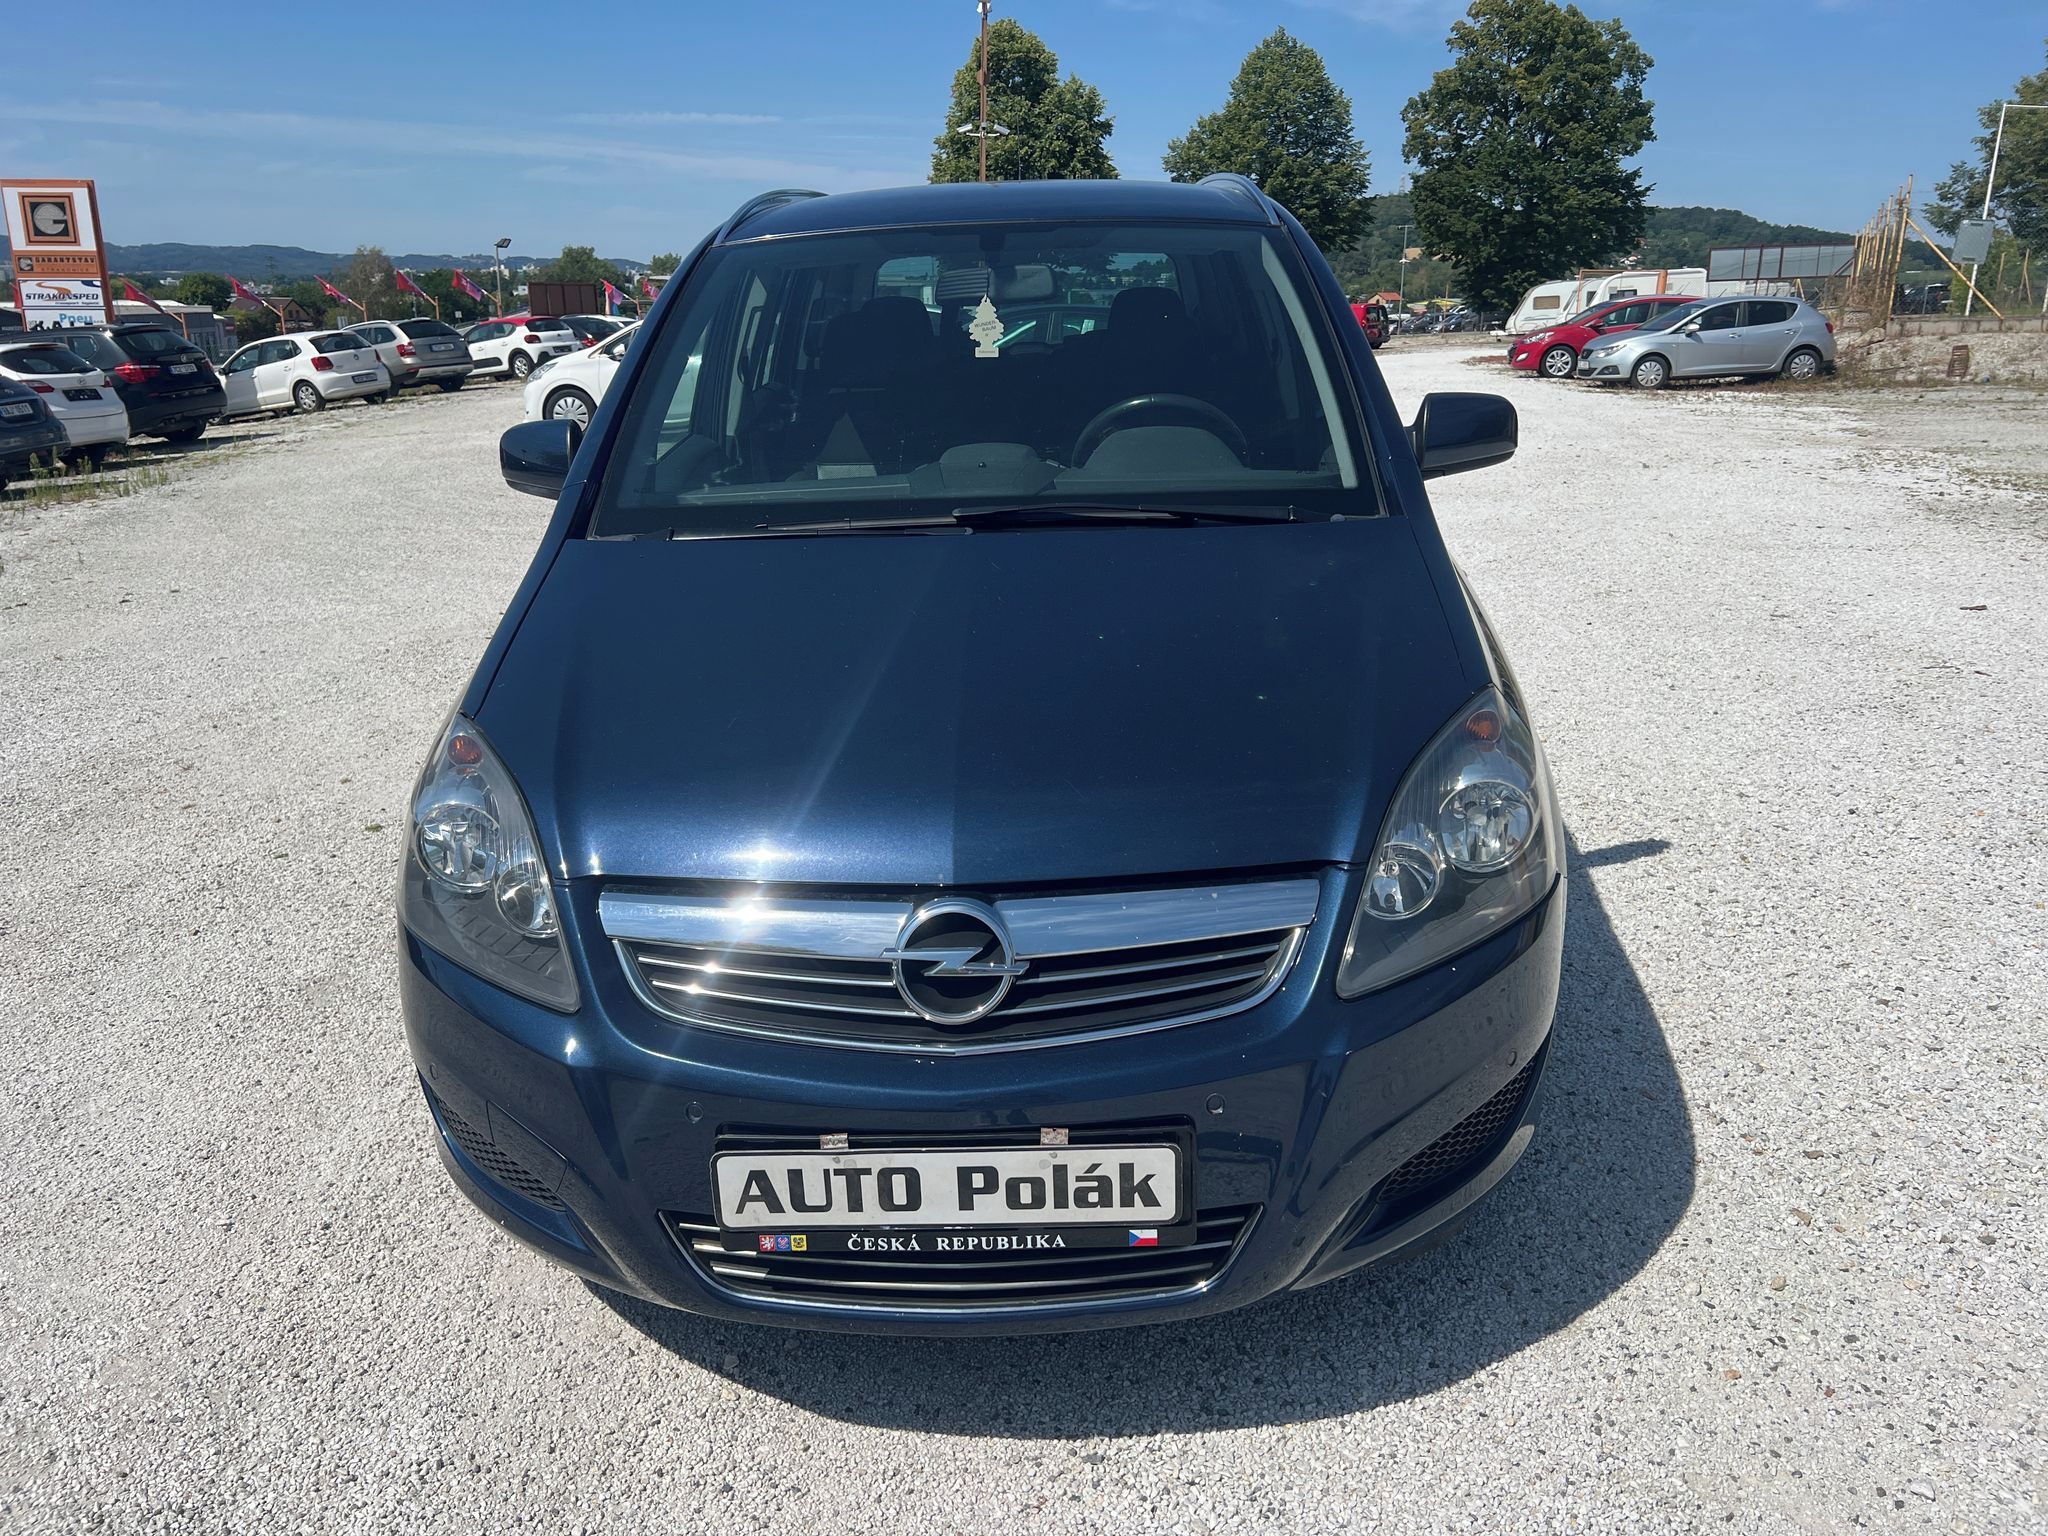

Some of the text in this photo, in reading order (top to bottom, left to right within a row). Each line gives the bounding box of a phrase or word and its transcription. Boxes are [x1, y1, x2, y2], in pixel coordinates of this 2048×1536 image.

[59, 313, 92, 324] Pneu
[735, 1163, 1162, 1214] AUTO Polák
[847, 1233, 1066, 1251] ČESKÁ REPUBLIKA
